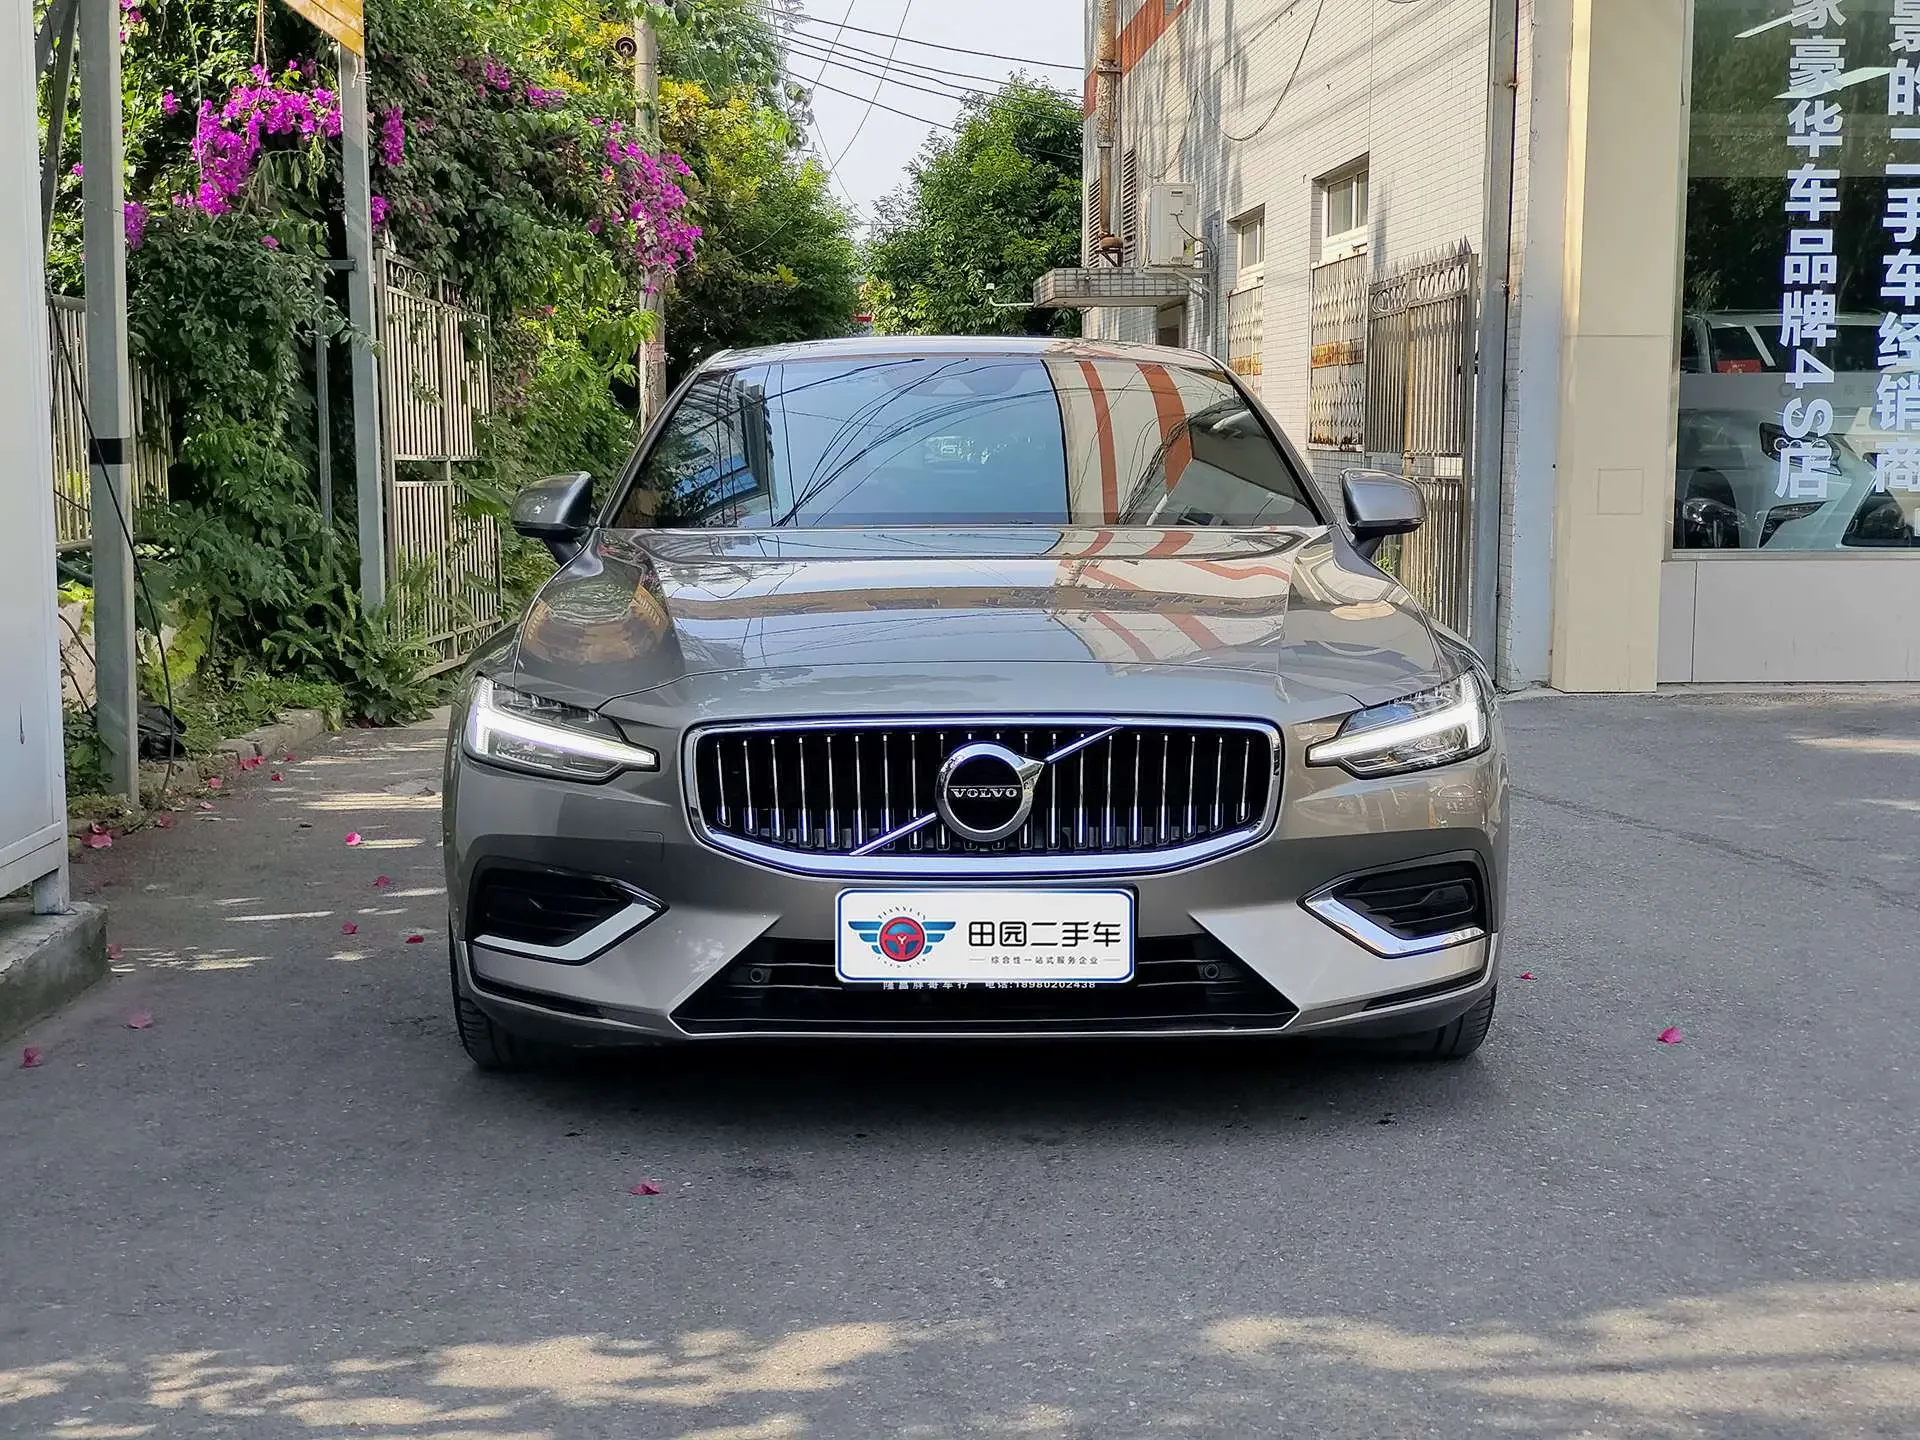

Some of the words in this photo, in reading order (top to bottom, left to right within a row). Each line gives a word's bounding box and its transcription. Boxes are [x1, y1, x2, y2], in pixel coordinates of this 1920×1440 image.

[951, 788, 1017, 798] VOLVO
[968, 921, 1121, 947] 田园二手车
